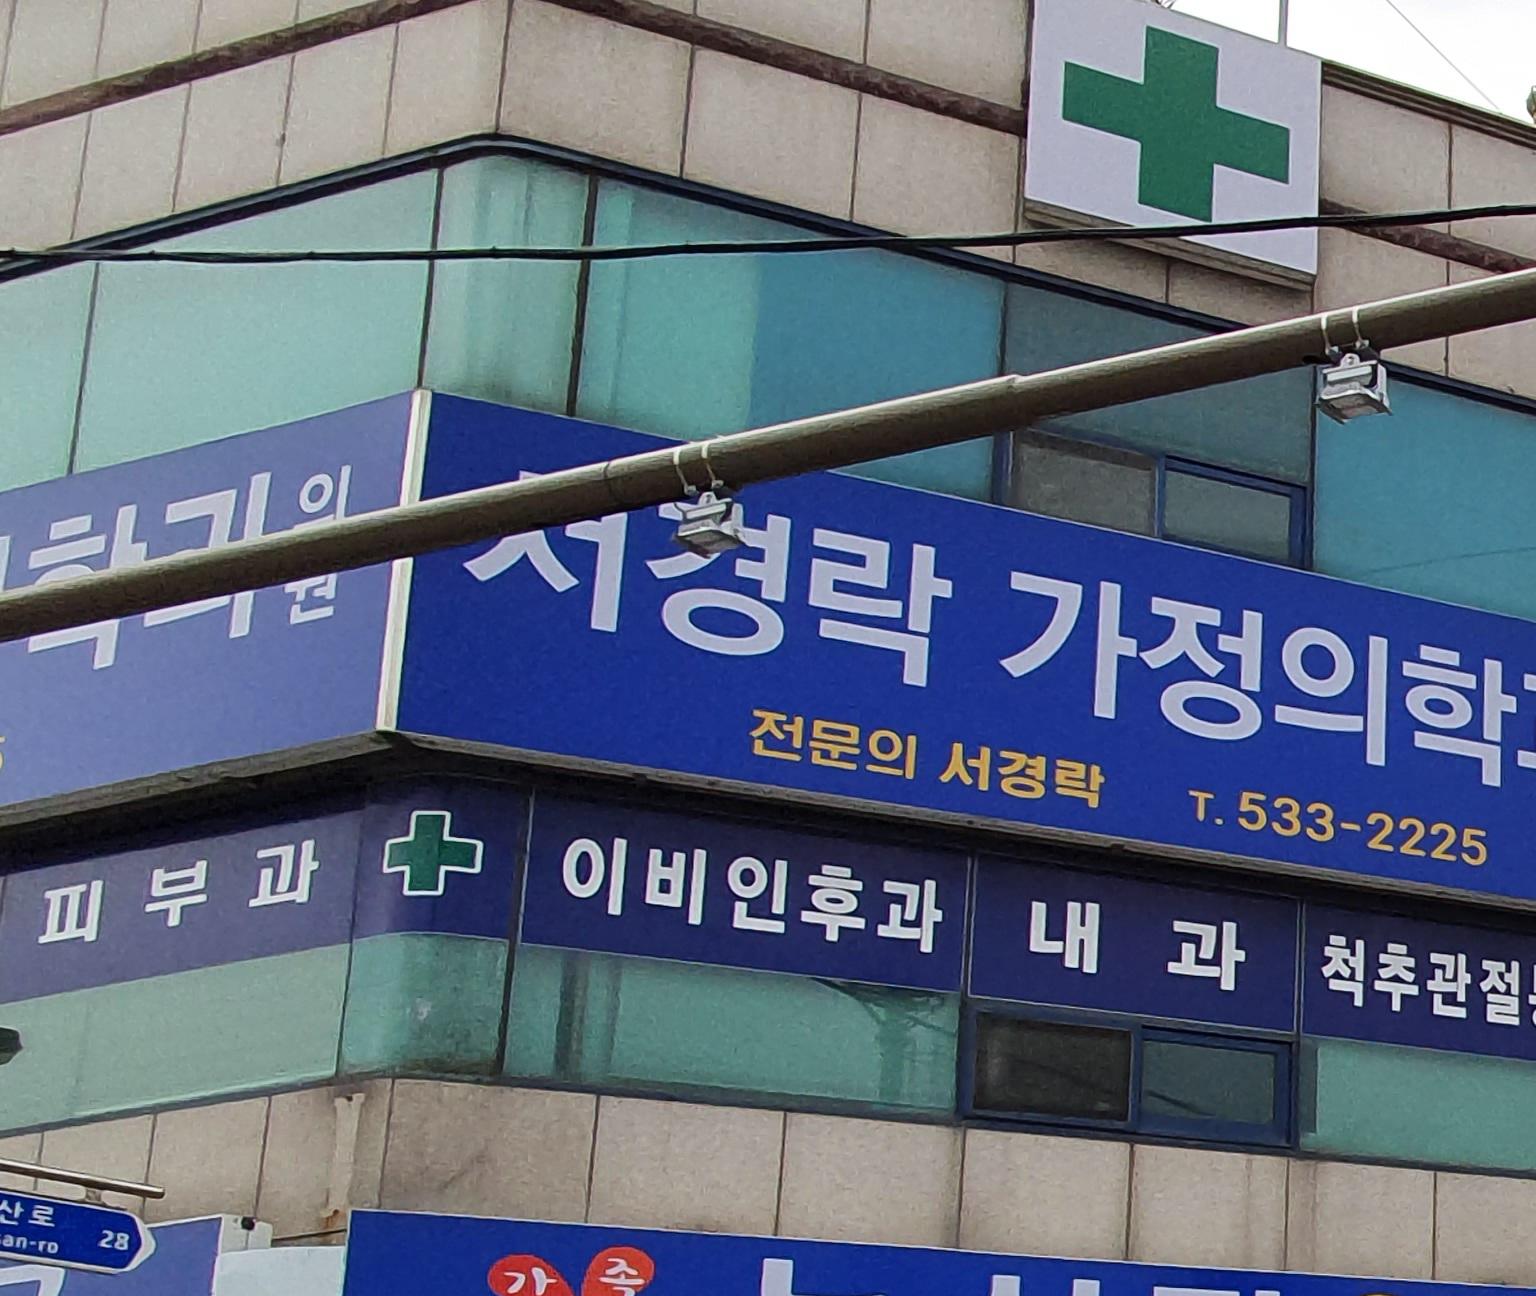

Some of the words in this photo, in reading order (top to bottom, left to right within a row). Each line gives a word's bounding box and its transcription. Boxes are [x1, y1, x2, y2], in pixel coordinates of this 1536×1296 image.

[463, 470, 953, 687] 서경락
[750, 708, 917, 780] 전문의
[940, 740, 1105, 809] 서경락
[1237, 791, 1489, 867] 533-2225
[562, 836, 943, 954] 이비인후과
[0, 1232, 60, 1254] an-ro
[97, 1229, 131, 1251] 28
